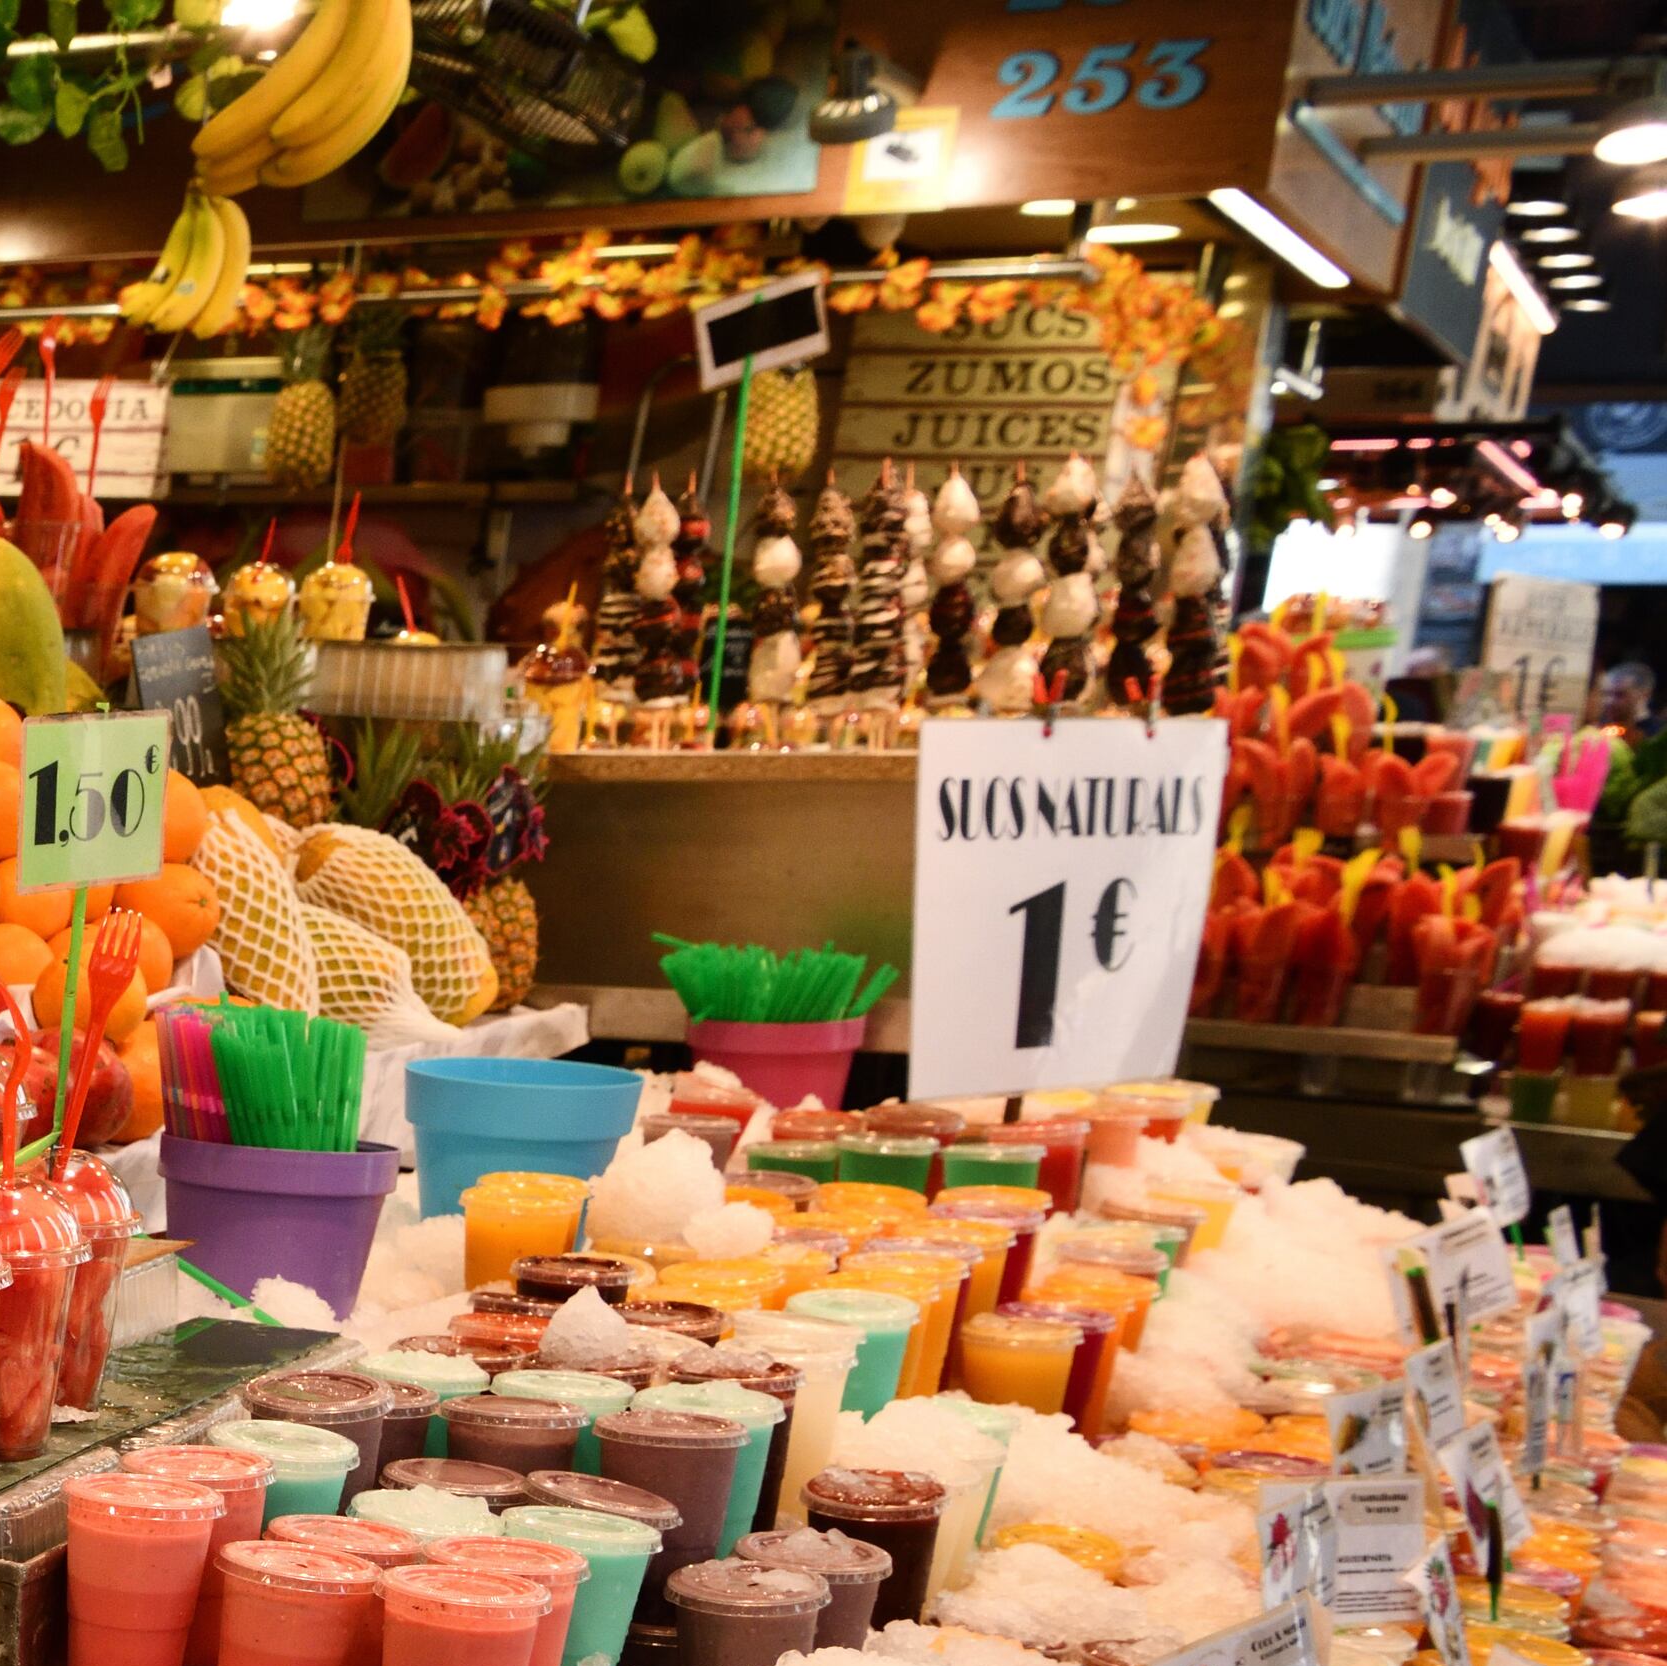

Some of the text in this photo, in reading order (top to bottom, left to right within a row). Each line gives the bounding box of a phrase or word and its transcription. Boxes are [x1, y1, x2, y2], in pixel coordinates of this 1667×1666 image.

[989, 37, 1213, 120] 253
[904, 359, 1110, 395] ZUMOS
[891, 411, 1101, 449] JUICES
[938, 776, 1208, 842] SUCS NATURALS
